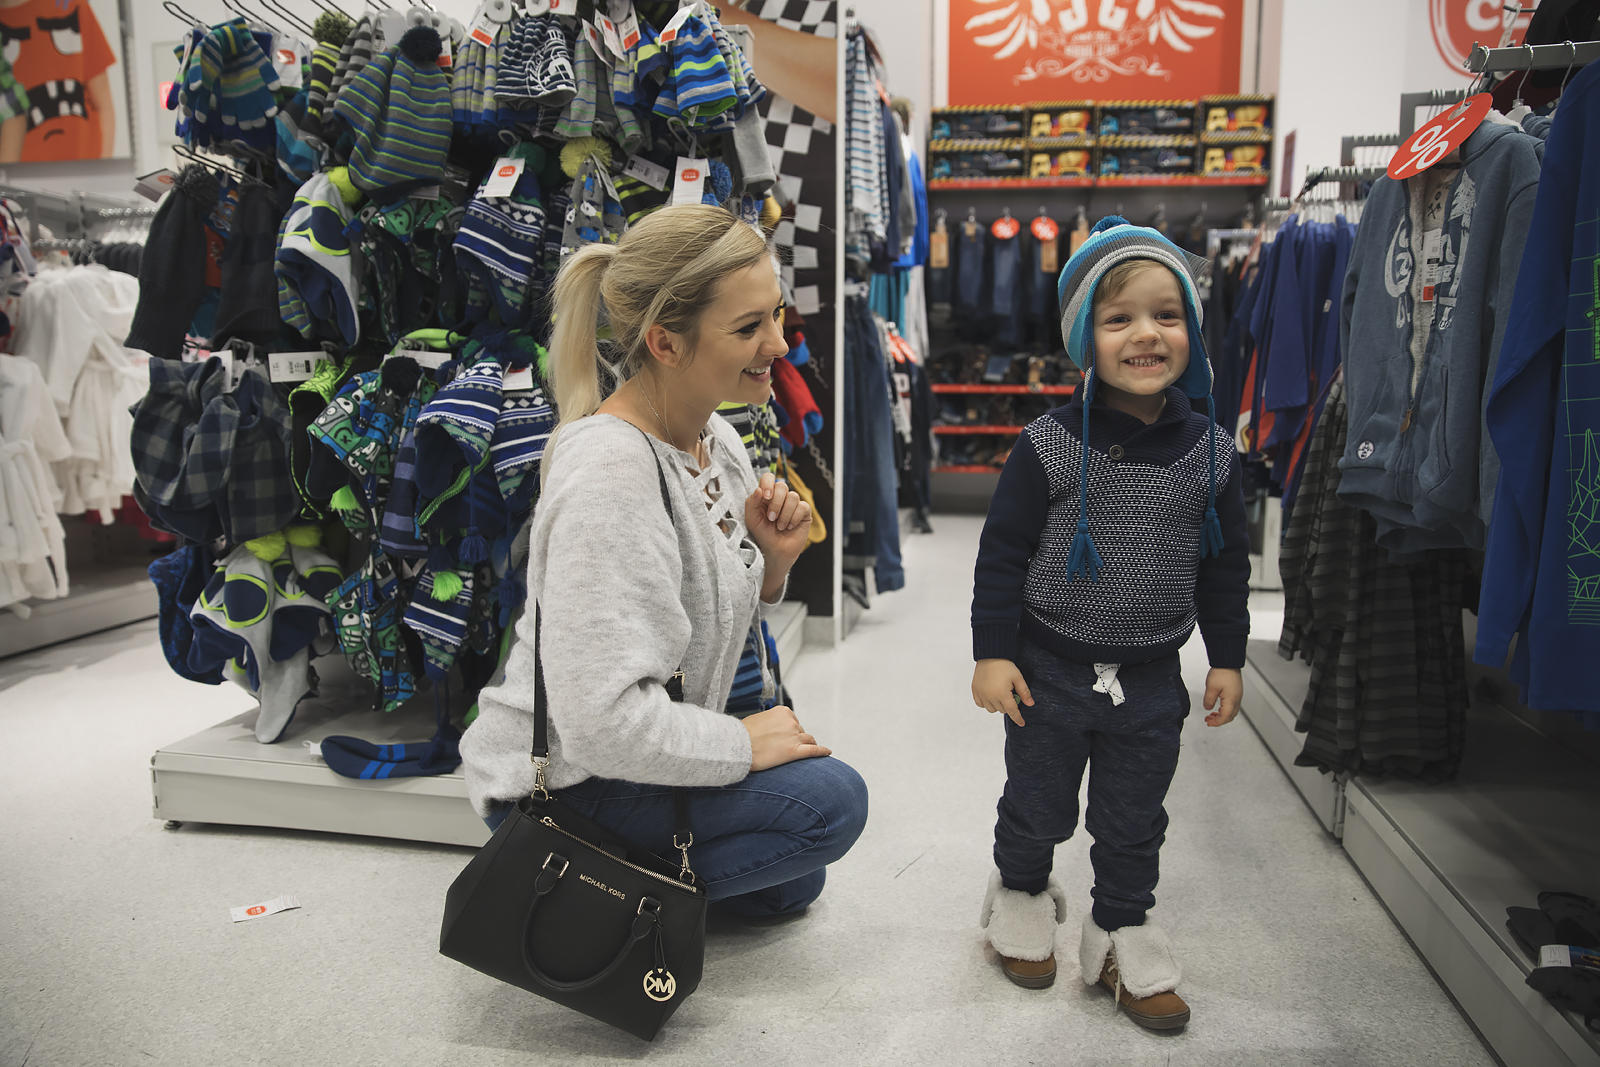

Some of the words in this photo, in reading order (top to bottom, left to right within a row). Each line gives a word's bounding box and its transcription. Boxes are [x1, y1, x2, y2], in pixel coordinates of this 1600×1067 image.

[1394, 116, 1466, 175] %
[580, 873, 607, 892] MICHAEL
[607, 887, 626, 900] KORS
